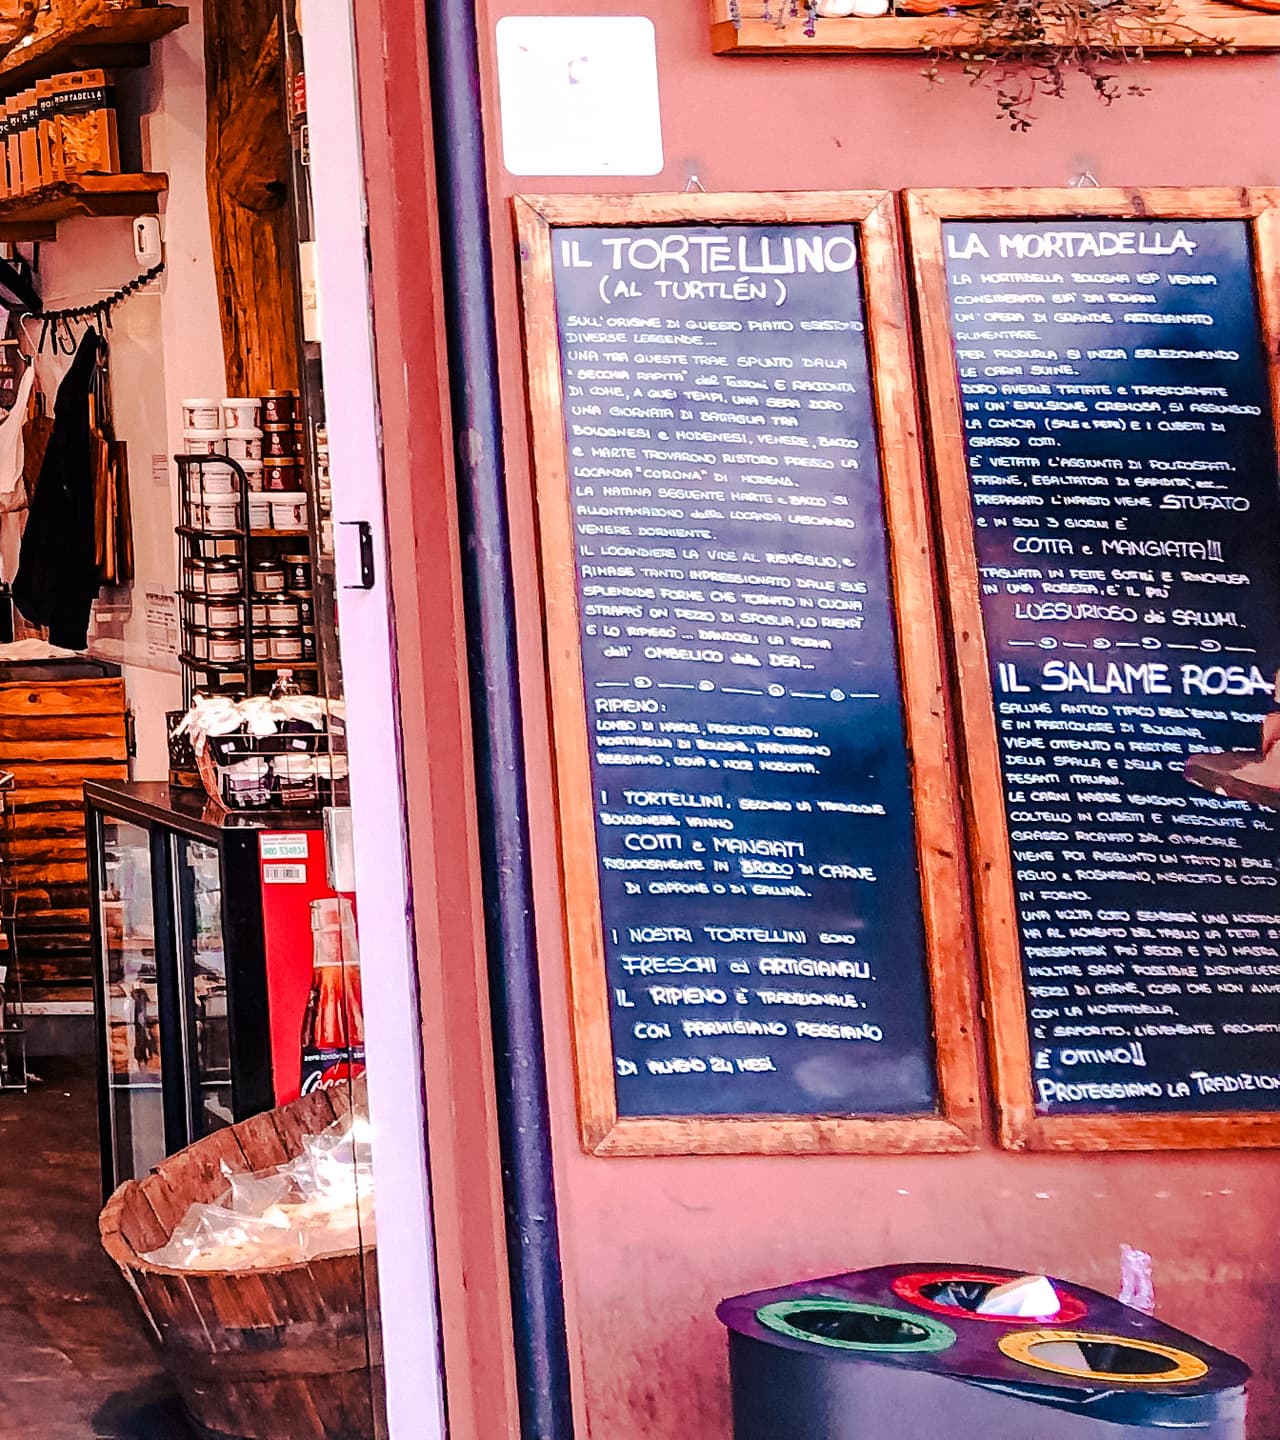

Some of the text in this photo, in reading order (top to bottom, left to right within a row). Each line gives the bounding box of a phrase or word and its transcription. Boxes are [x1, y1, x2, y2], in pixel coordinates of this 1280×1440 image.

[947, 229, 1199, 259] LA MORTADELLA
[561, 235, 856, 274] IL TORTELLINO
[980, 273, 1131, 285] MORTADELLA BOLOGNA
[666, 319, 680, 328] DI
[685, 320, 742, 332] QUESTO
[749, 321, 794, 332] PIATTO
[1053, 312, 1114, 324] GRANDE
[566, 332, 628, 344] DIVERSE
[568, 351, 848, 369] UNA TRA QUESTE TRAE SPUNTO DALLA
[609, 406, 674, 419] GIORNATA
[988, 418, 1036, 429] CONCIA
[969, 437, 1020, 448] GRASSO
[591, 448, 779, 466] MARTE TROVARONO RISTORO
[574, 466, 634, 478] LOCANDA
[576, 486, 725, 501] LA SEGUENTE
[1114, 494, 1250, 512] VIENE STUFATO
[578, 524, 632, 536] VENERE
[1013, 536, 1074, 555] COTTA
[1082, 545, 1093, 556] e
[707, 551, 760, 562] VIDE AL
[640, 568, 685, 580] TANTO
[1015, 602, 1138, 622] LUSSURIOSO
[644, 648, 724, 663] OMBELICO
[998, 660, 1276, 696] IL SALAME ROSA
[624, 833, 805, 858] COTTI e MANGIATI
[1075, 831, 1134, 843] RICAVATO
[713, 860, 729, 872] IN
[741, 859, 794, 877] BRODO
[819, 863, 877, 882] CARNE
[630, 927, 693, 943] NOSTRI
[704, 926, 807, 944] TORTELLINI
[621, 956, 717, 977] FRESCHI
[615, 988, 635, 1008] IL
[649, 986, 728, 1006] RIPIENO
[634, 1020, 883, 1042] CON PARMIGIANO REGGIANO
[616, 1058, 638, 1076] DI
[1037, 1078, 1162, 1103] PROTEGGIAMO
[1167, 1084, 1190, 1097] LA
